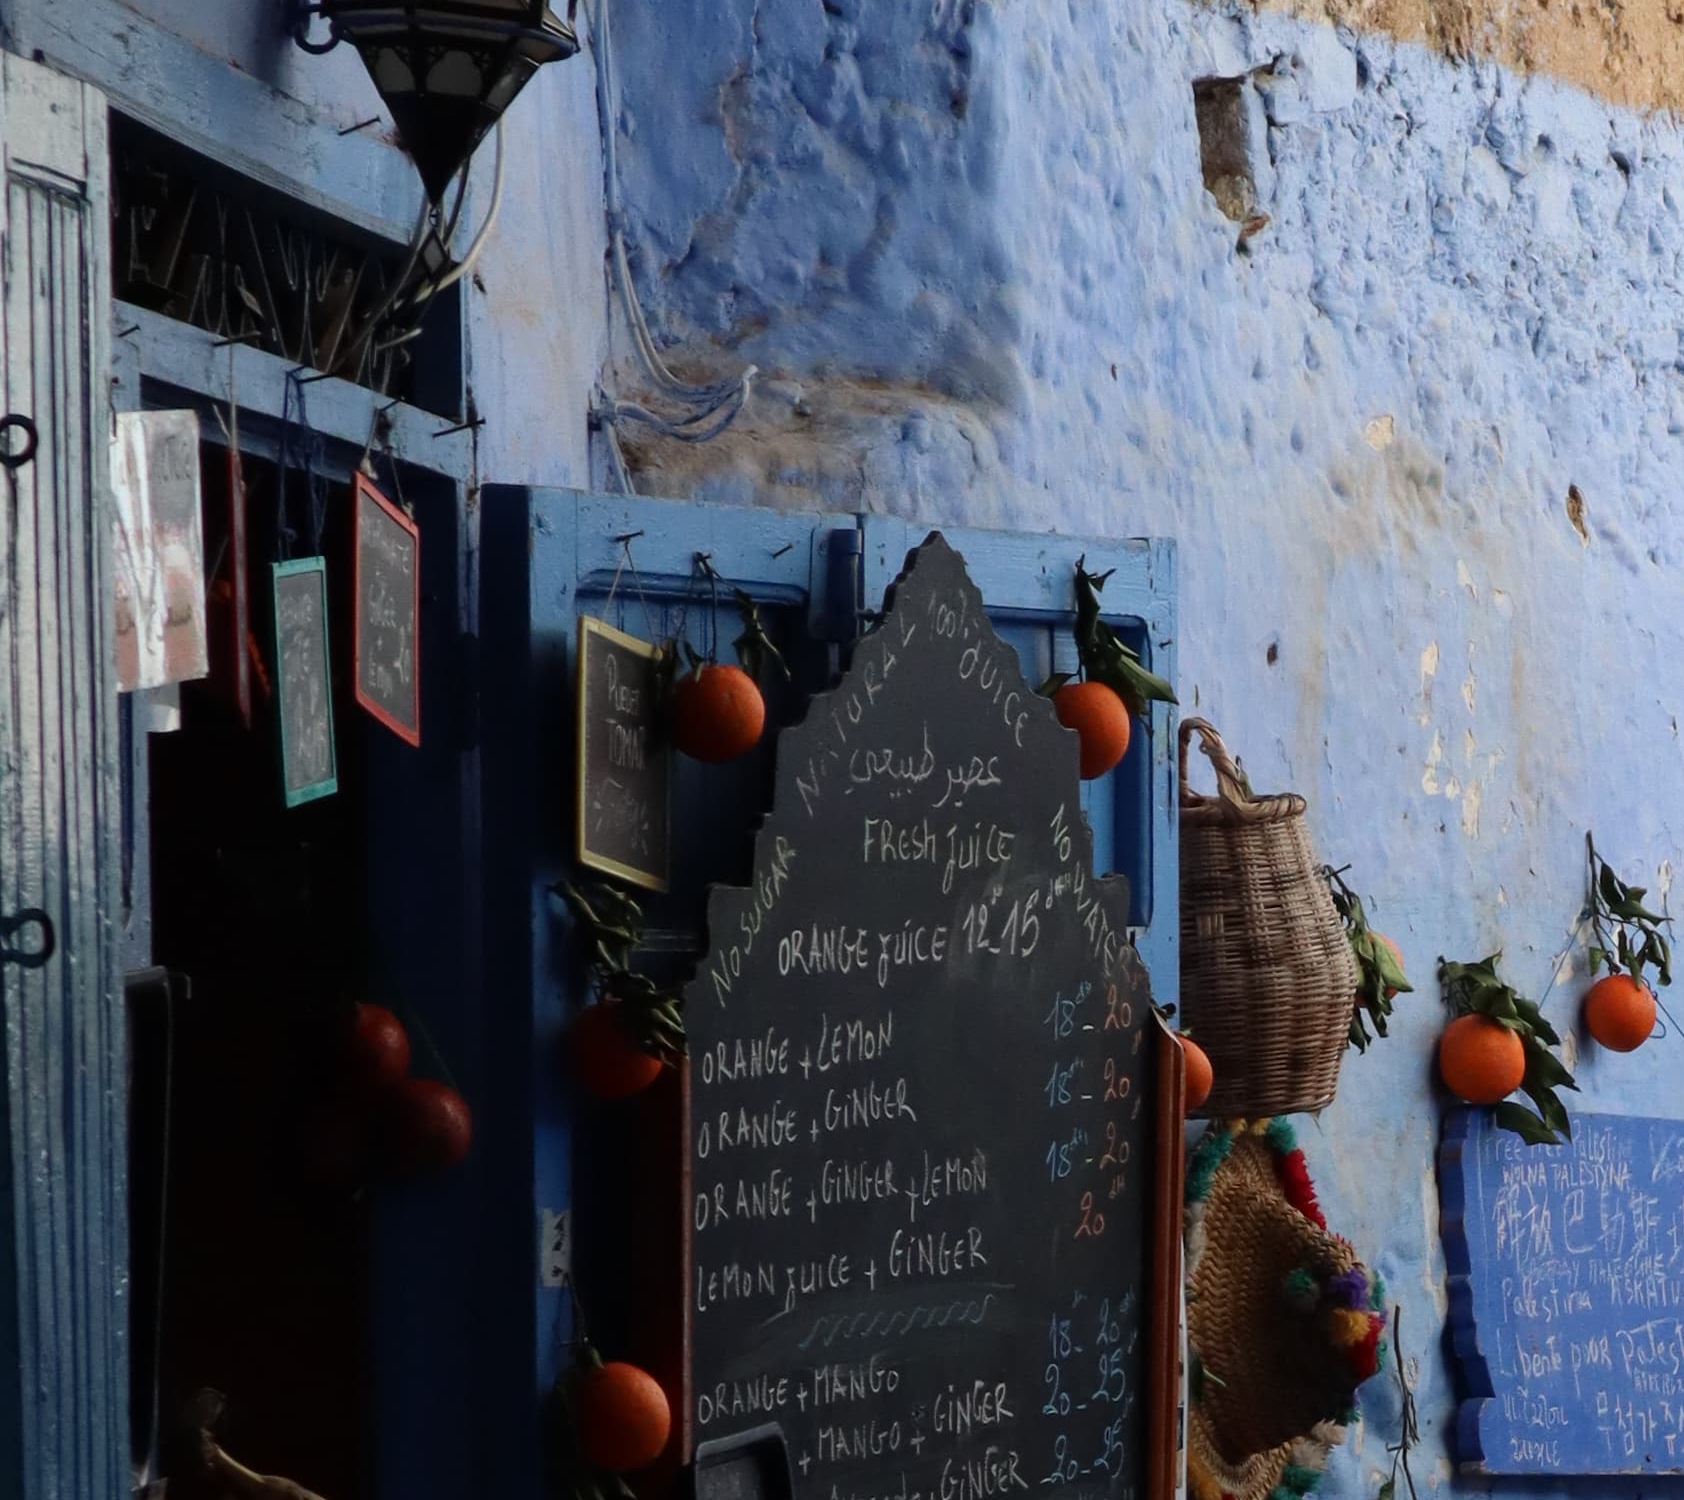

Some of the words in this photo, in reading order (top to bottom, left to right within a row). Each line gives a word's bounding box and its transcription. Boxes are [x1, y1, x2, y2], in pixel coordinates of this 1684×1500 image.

[933, 756, 1002, 810] عصير
[778, 922, 868, 976] ORANGE
[702, 1026, 789, 1085] ORANGE
[818, 1011, 894, 1073] LEMON
[699, 1100, 798, 1159] ORANGE
[695, 1168, 793, 1231] ORANGE
[921, 1146, 988, 1206] LEMON
[697, 1262, 775, 1312] LEMON
[699, 1376, 788, 1426] ORANGE
[814, 1354, 900, 1406] MANGO
[817, 1420, 900, 1462] MANGO
